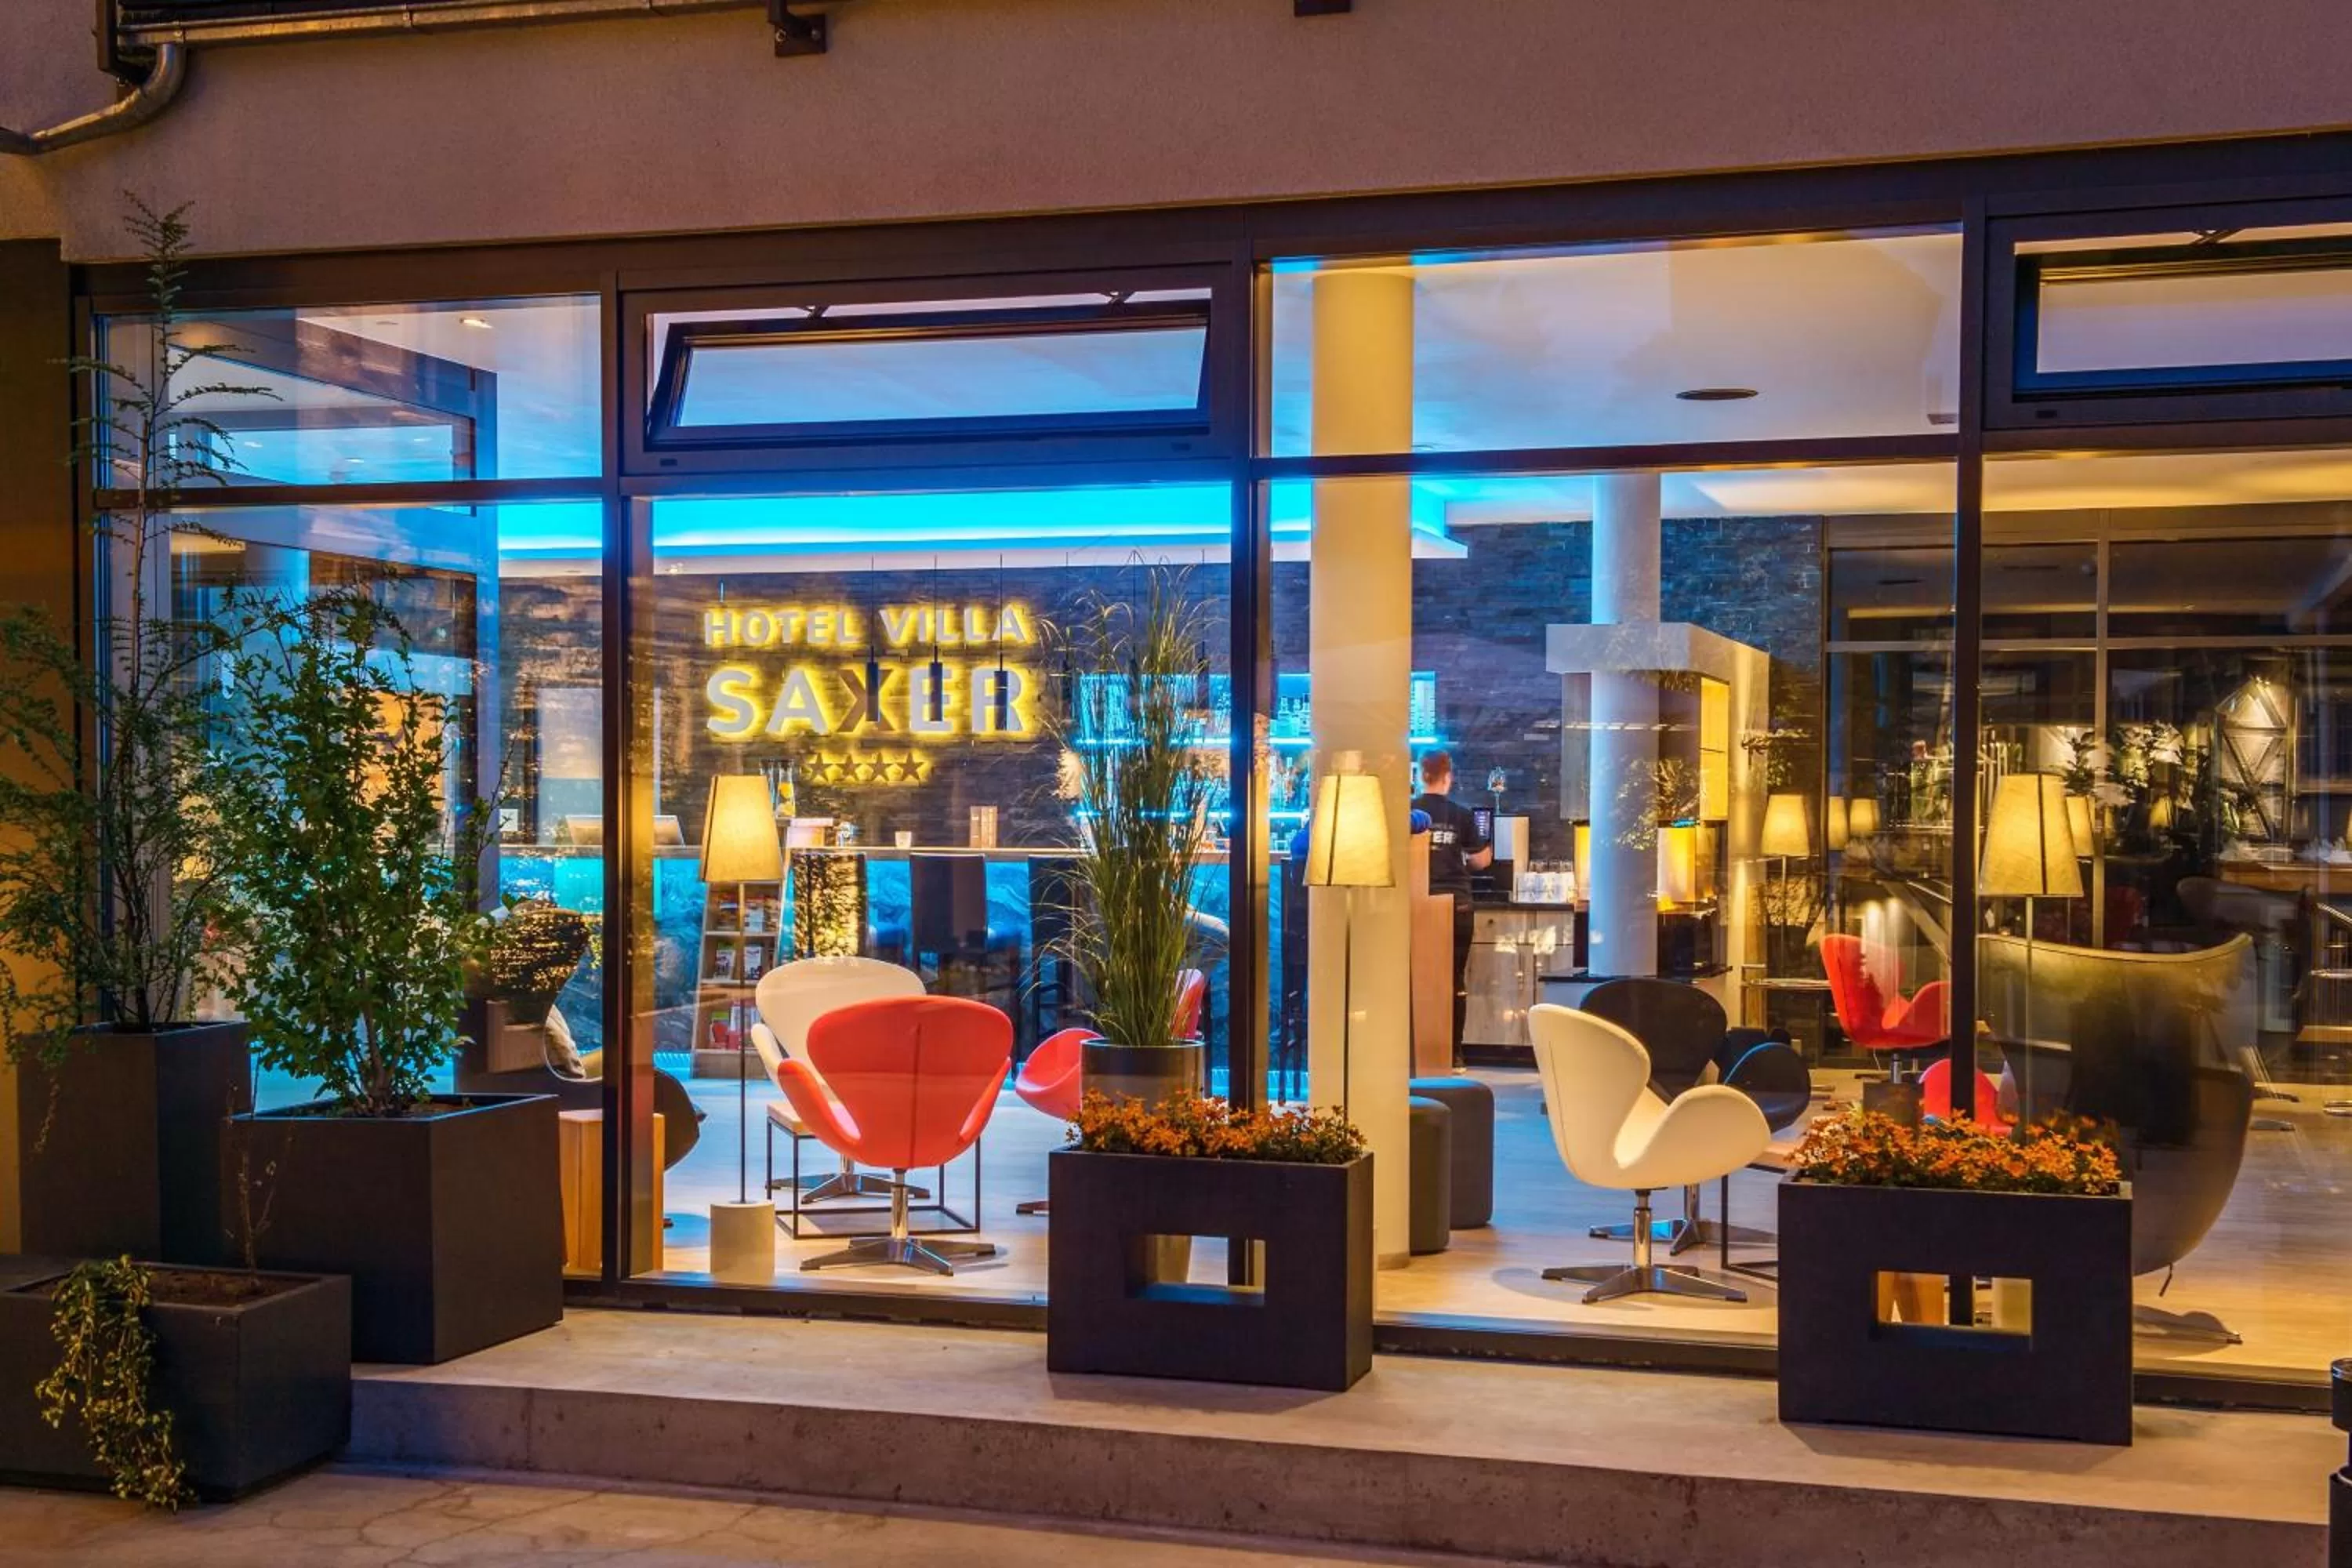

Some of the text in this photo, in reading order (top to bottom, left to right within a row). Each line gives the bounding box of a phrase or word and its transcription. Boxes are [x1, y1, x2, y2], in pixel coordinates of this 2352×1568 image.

[704, 607, 1026, 645] HOTEL VILLA
[706, 668, 1023, 733] SAXER
